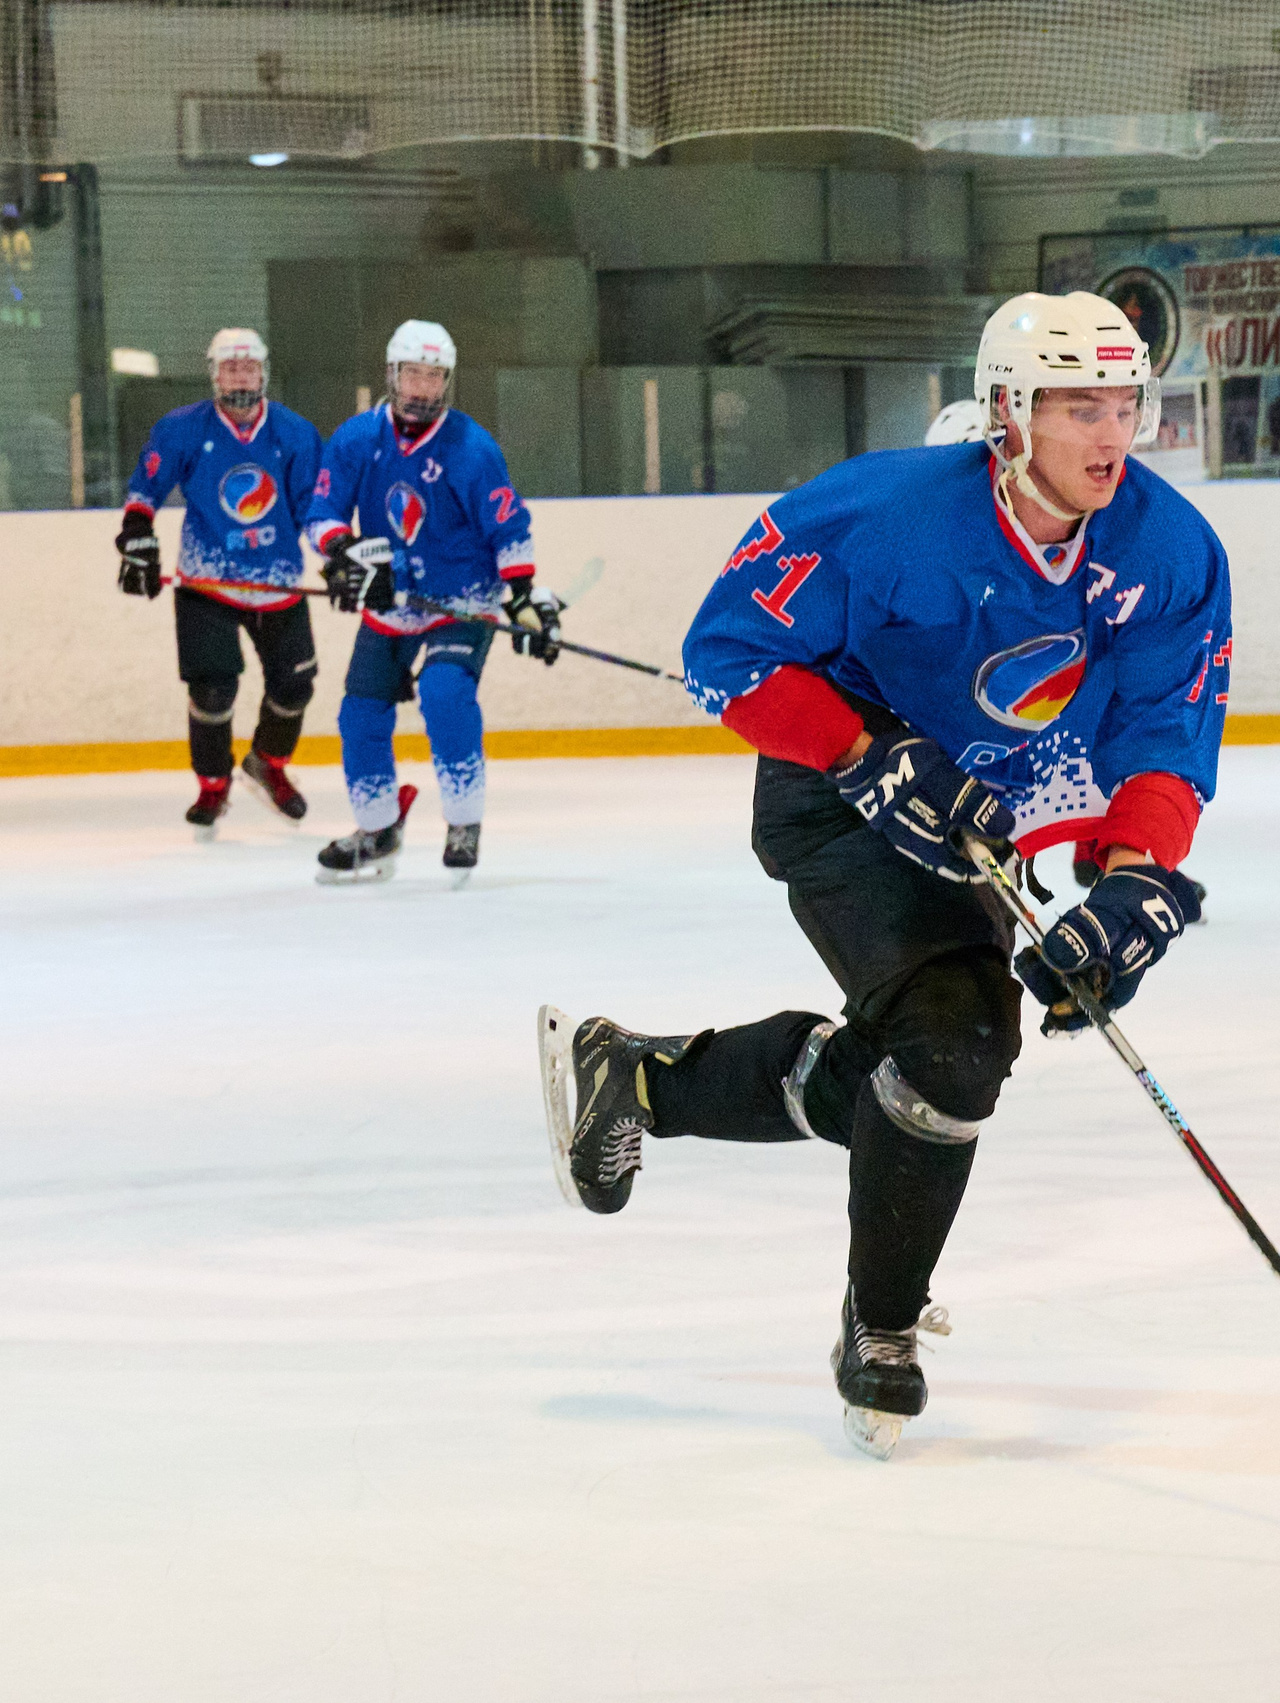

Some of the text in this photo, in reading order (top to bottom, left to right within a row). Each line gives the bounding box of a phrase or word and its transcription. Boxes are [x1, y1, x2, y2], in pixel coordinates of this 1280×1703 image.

[987, 363, 1014, 373] CCM
[489, 485, 527, 524] 2
[720, 508, 822, 629] 71
[1085, 560, 1146, 626] 71
[854, 750, 916, 822] CM
